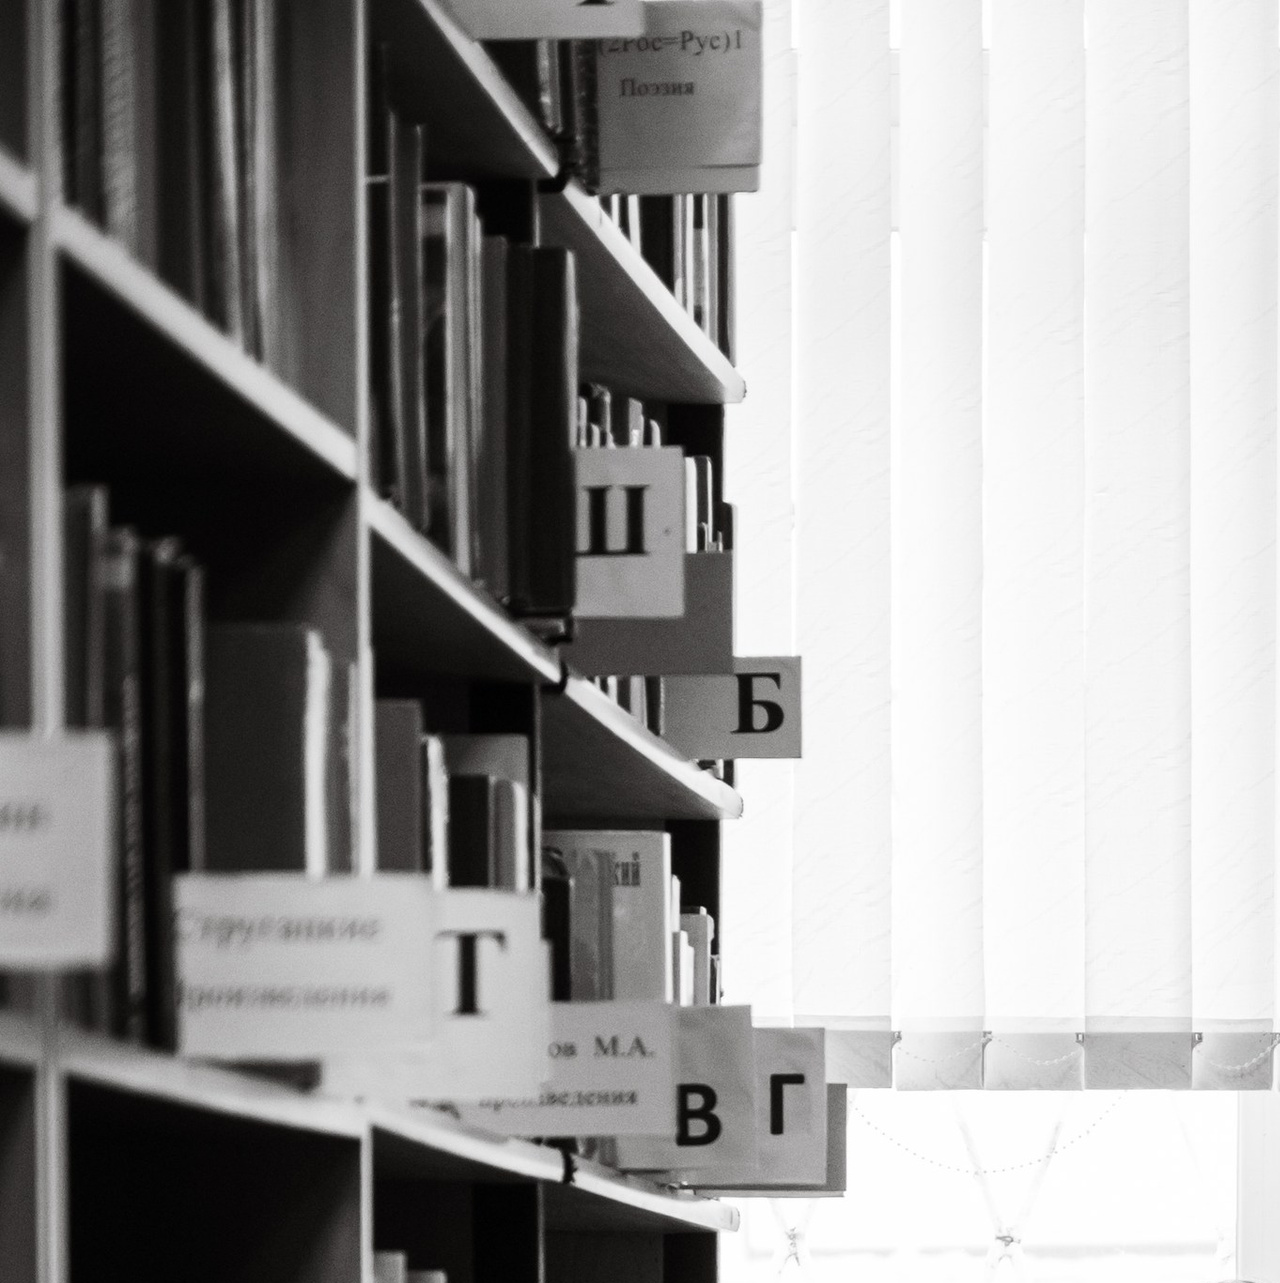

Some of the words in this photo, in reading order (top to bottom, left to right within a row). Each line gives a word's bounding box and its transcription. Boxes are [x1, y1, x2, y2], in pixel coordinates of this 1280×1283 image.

[619, 78, 694, 97] Поэзия
[731, 673, 785, 733] Б
[434, 929, 507, 1018] Т
[593, 1034, 657, 1058] М.А.
[676, 1084, 722, 1146] В
[770, 1073, 805, 1135] Г
